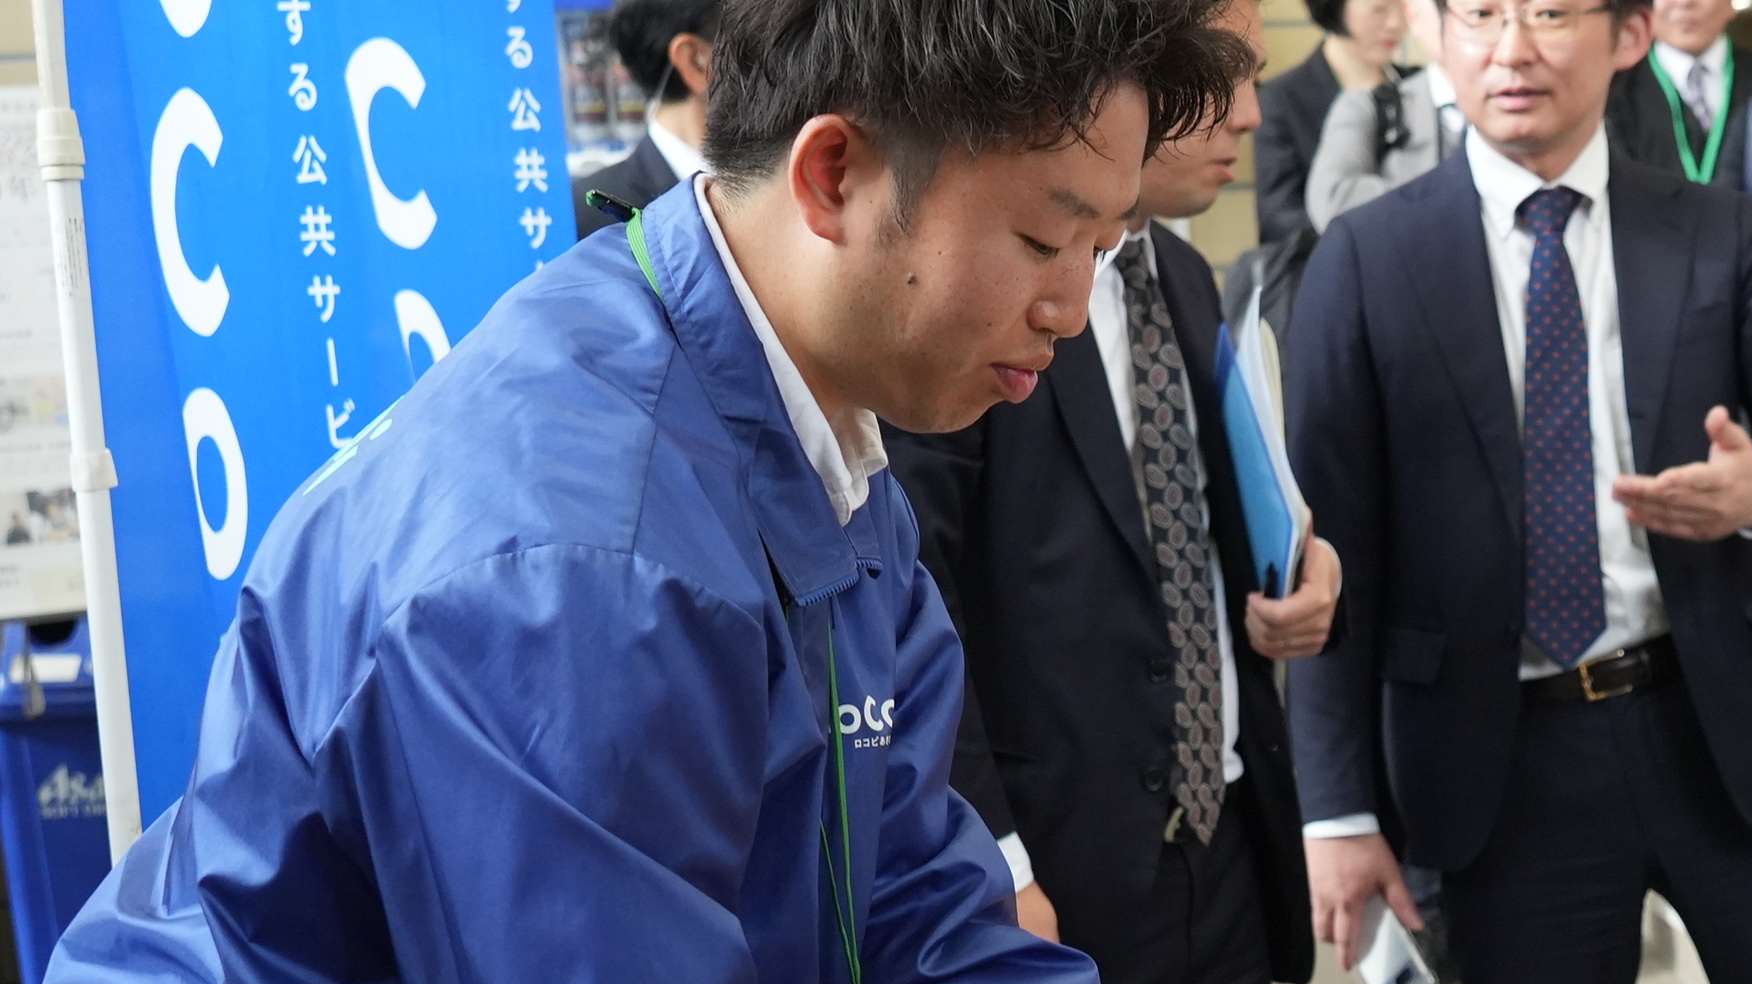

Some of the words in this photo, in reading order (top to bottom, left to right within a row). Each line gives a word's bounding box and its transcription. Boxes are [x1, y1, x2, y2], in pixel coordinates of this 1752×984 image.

[151, 0, 247, 580] Co
[504, 0, 552, 270] る公共サ
